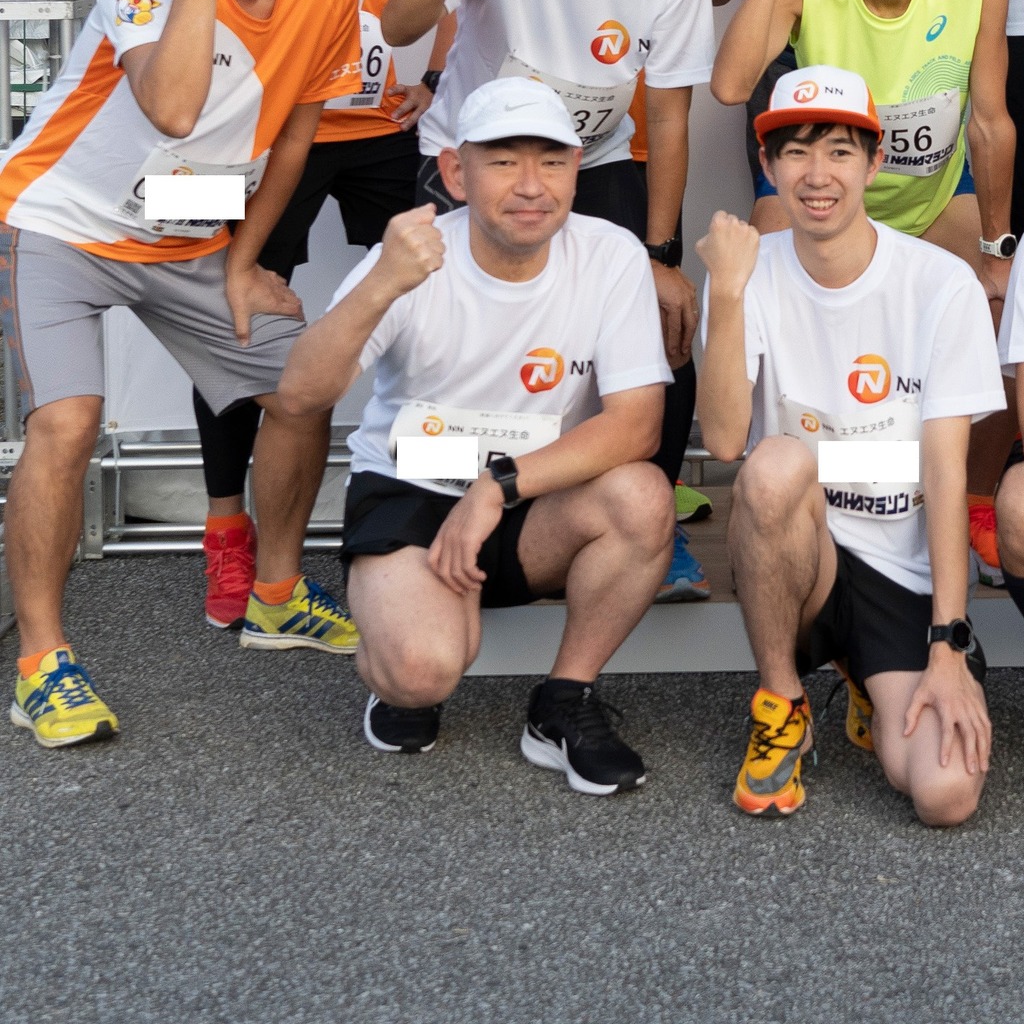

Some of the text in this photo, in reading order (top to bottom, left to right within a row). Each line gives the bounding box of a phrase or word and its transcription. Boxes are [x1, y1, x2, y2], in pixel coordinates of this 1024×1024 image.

[824, 86, 844, 96] NN
[884, 107, 936, 122] エヌエヌ生命
[890, 143, 955, 167] NAHAマラソン
[896, 376, 921, 394] NN
[470, 426, 531, 441] エヌエヌ生命
[839, 417, 896, 436] エヌエヌ生命
[824, 486, 909, 516] NAHAマラソン
